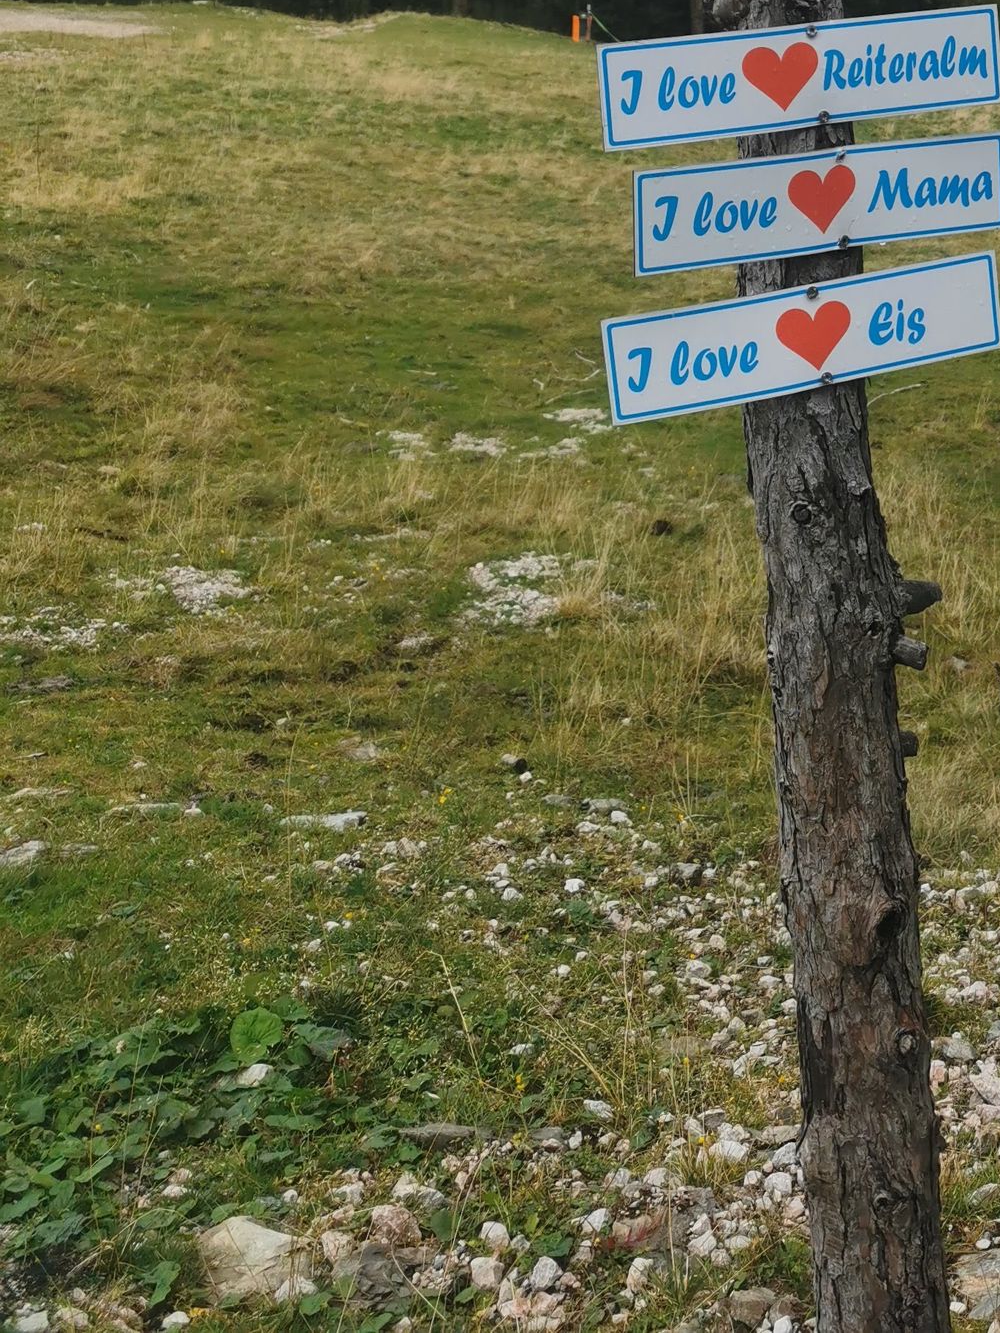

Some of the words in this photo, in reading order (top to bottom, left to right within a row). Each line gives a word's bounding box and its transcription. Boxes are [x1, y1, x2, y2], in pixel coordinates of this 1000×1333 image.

[620, 70, 643, 116] I
[657, 67, 736, 111] love
[823, 36, 988, 90] Reiteralm
[652, 196, 678, 242] I
[693, 192, 777, 237] love
[867, 168, 993, 213] Mama
[628, 347, 652, 393] I
[670, 341, 758, 386] love
[868, 299, 926, 346] Eis
